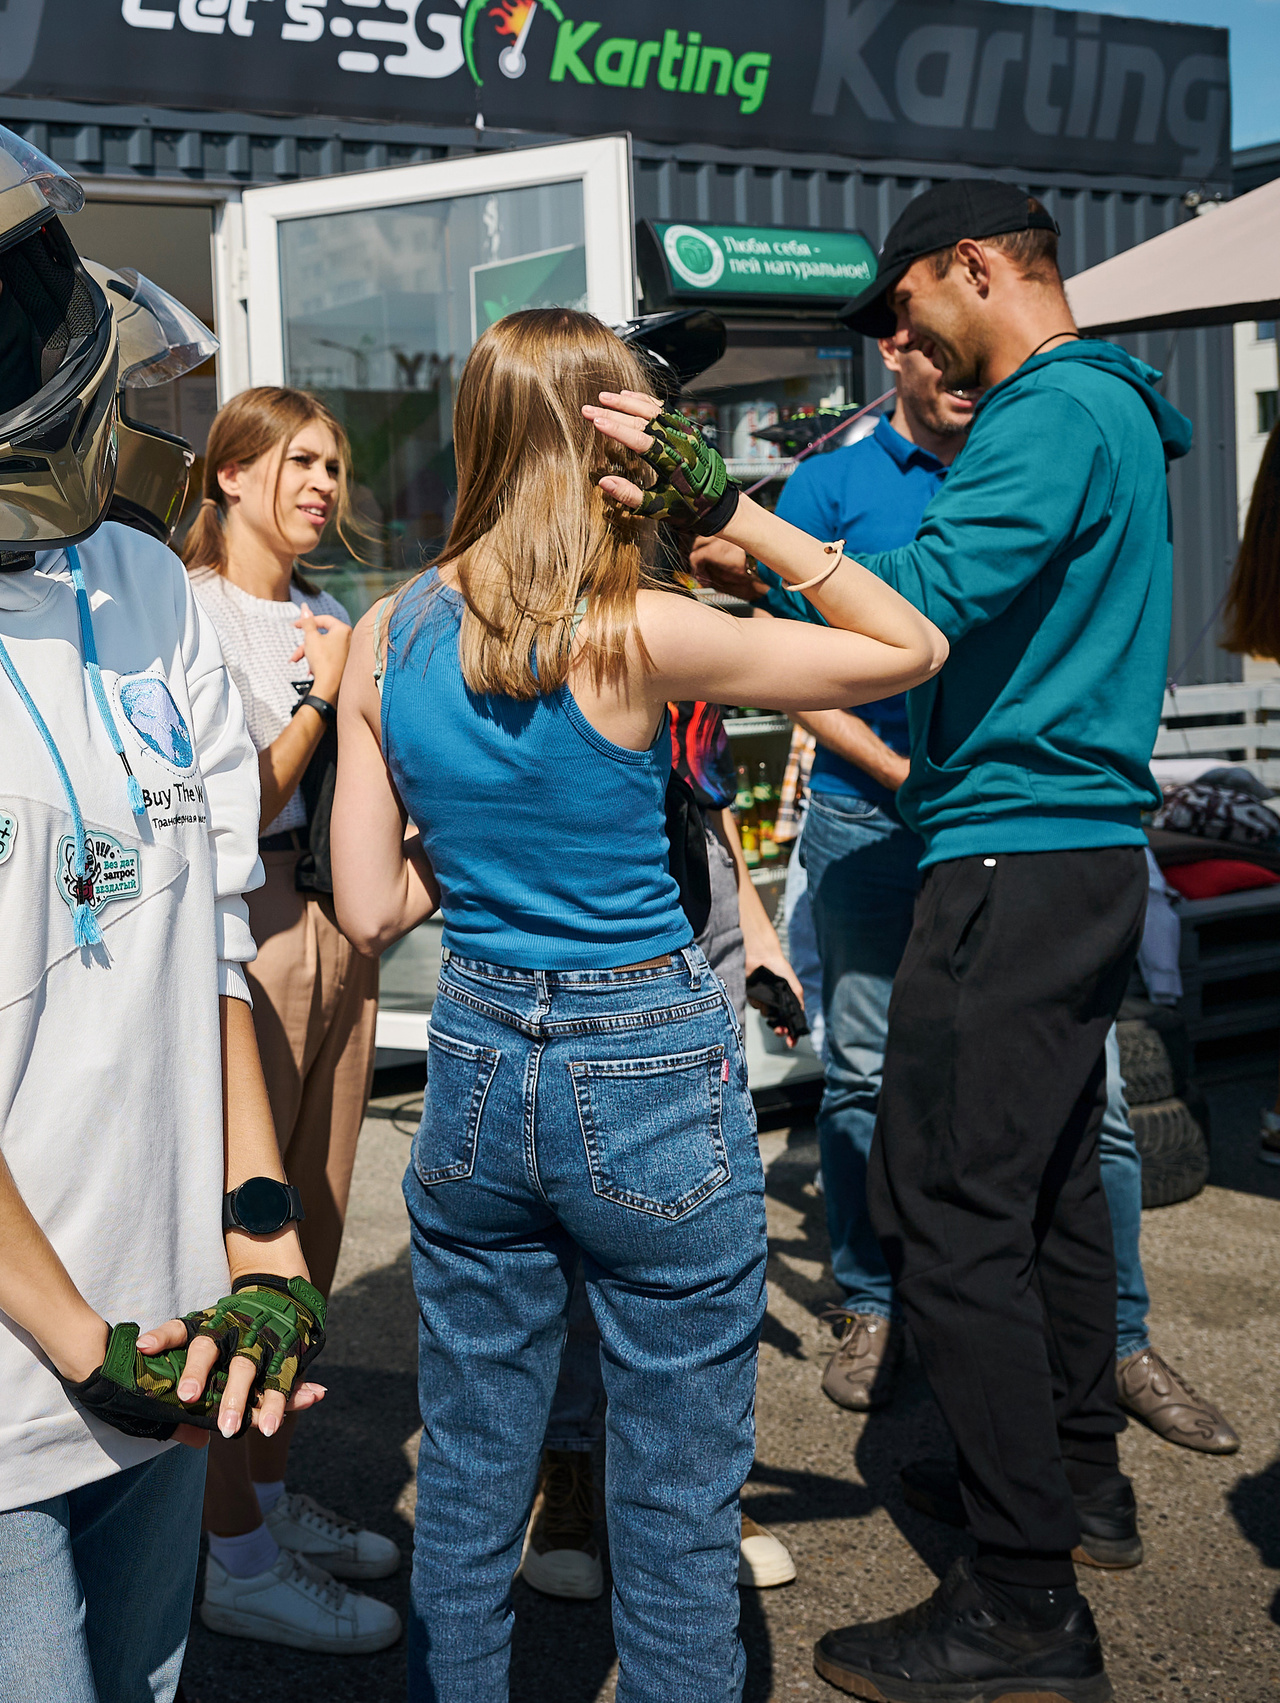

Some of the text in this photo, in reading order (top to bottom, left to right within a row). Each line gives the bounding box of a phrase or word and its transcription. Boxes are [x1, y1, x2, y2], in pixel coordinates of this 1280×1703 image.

[121, 0, 324, 42] Lets
[549, 19, 771, 114] Karting
[811, 0, 1231, 179] Karting
[723, 236, 771, 254] Люби
[773, 240, 812, 257] себя
[729, 257, 871, 280] пей натуральное!
[142, 788, 171, 809] Buy
[173, 782, 196, 802] The
[103, 860, 118, 870] Без
[103, 868, 135, 880] запрос
[95, 879, 136, 894] БЕЗДАТЫЙ
